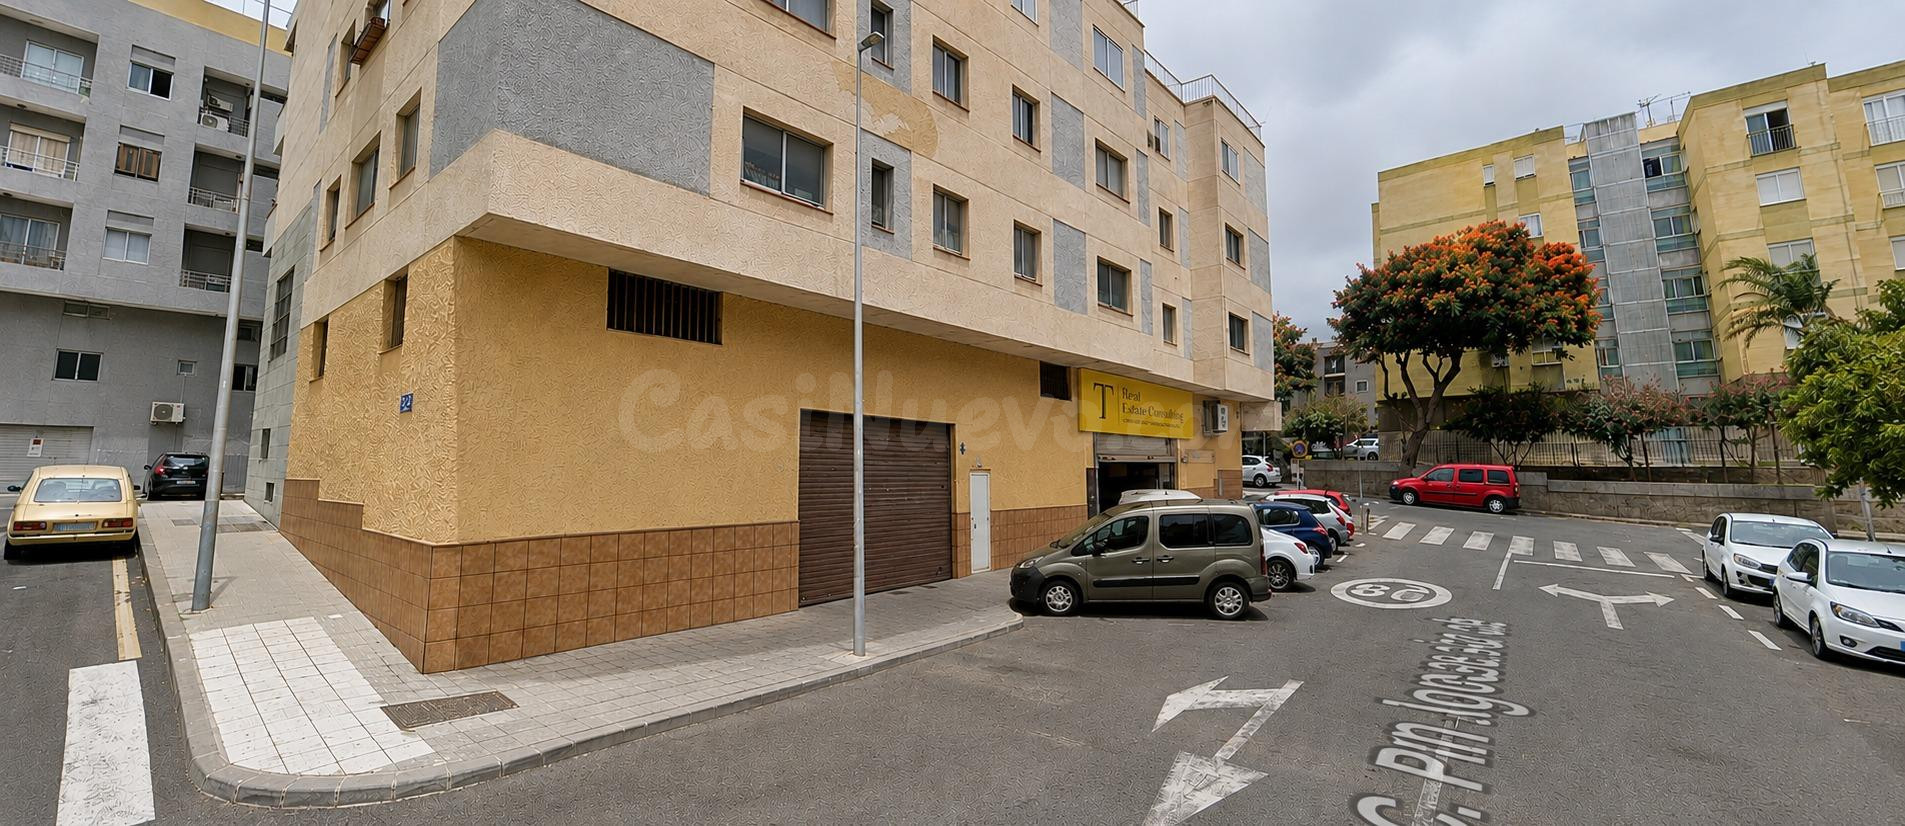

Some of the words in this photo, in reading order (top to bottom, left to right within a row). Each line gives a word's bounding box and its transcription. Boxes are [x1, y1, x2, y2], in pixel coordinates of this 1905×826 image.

[1093, 382, 1114, 419] T
[1122, 386, 1141, 402] Real
[1122, 402, 1147, 416] Estate
